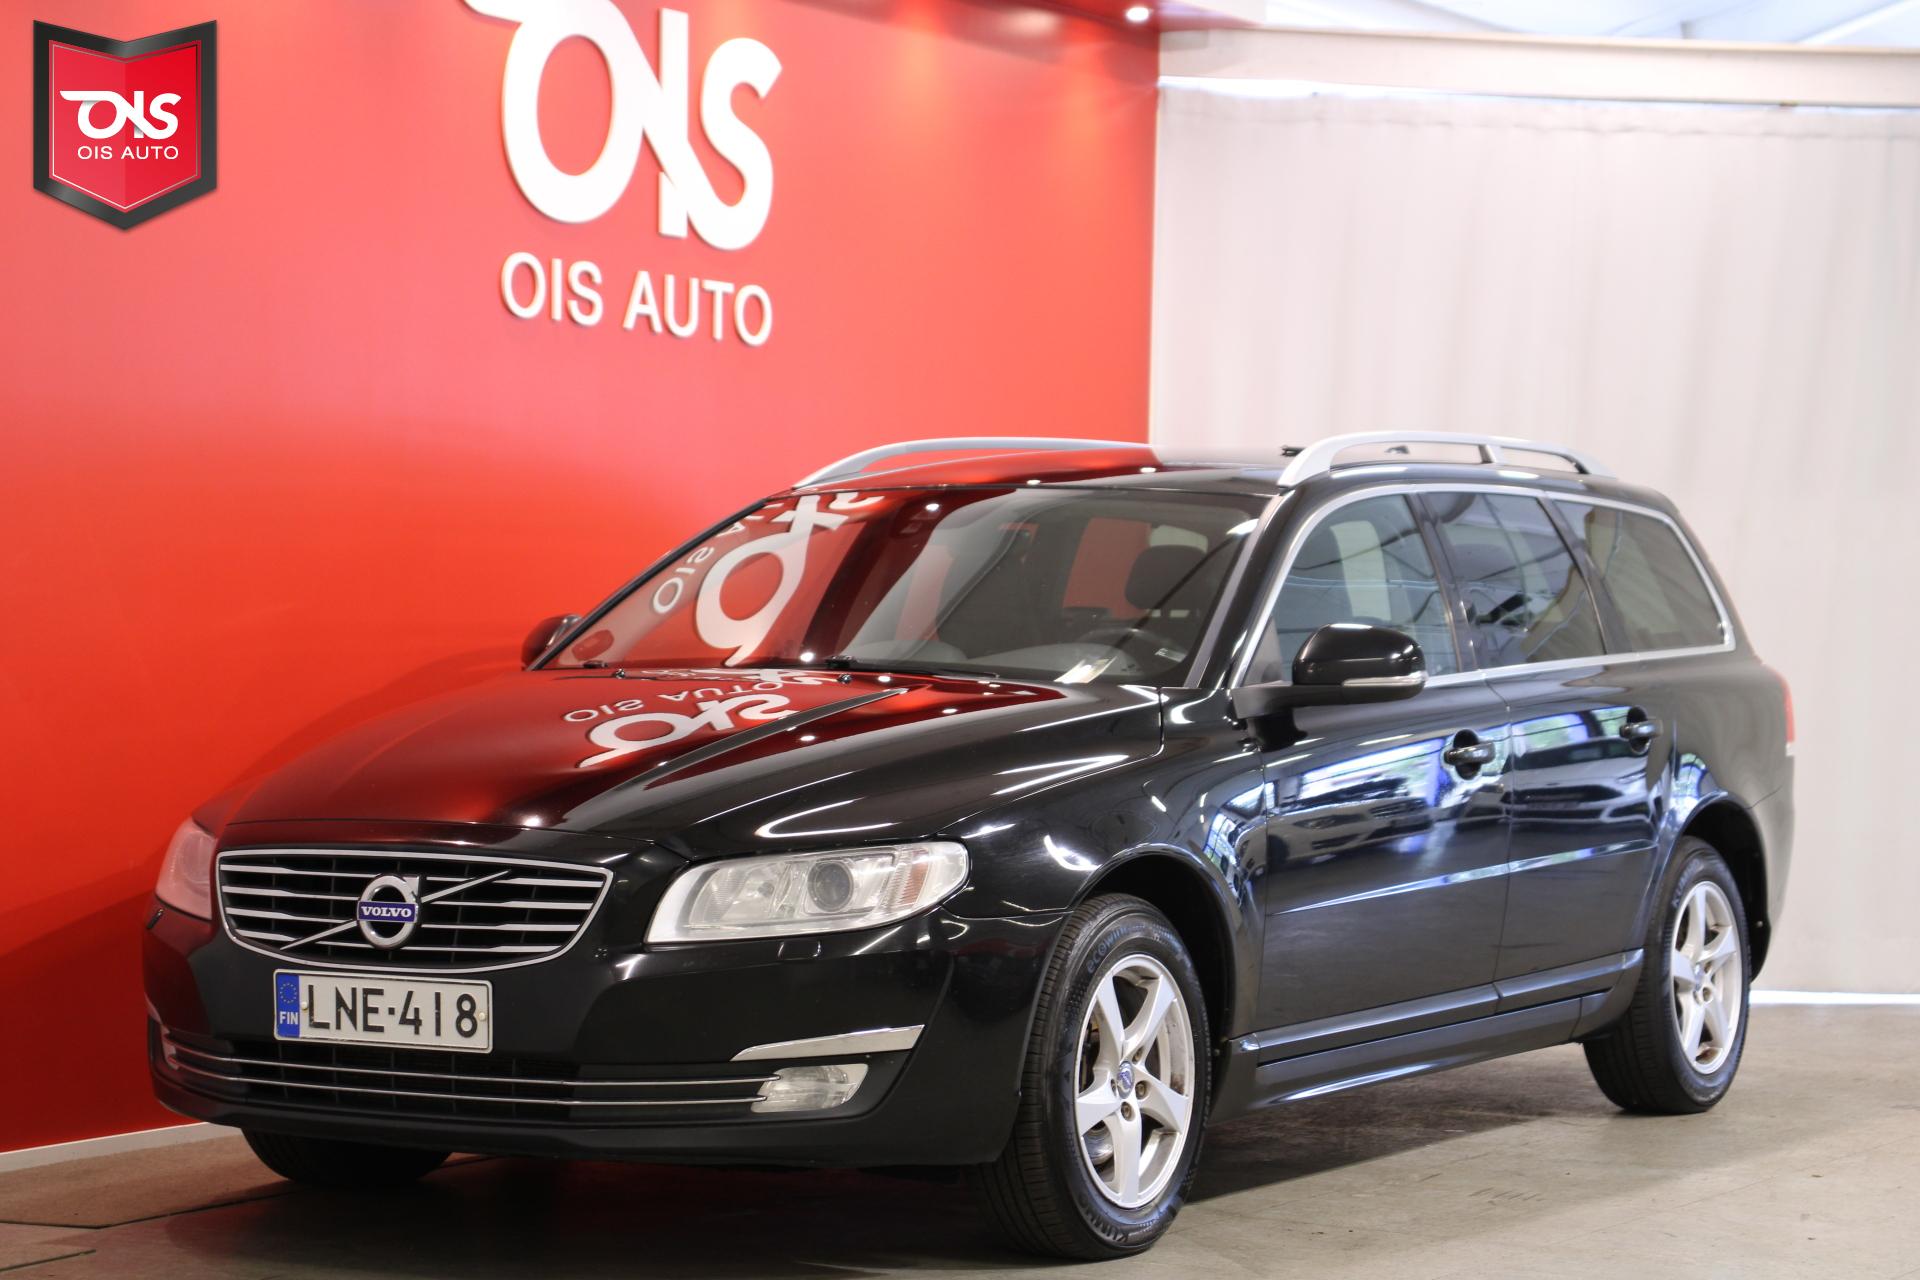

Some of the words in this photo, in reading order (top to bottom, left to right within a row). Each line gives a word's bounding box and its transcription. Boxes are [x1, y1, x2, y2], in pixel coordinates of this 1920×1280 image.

[463, 0, 782, 251] OIS
[501, 252, 604, 326] OIS
[622, 270, 773, 347] AUTO
[361, 905, 412, 918] VOLVO
[279, 1010, 299, 1025] FIN
[308, 984, 478, 1039] LNE-418
